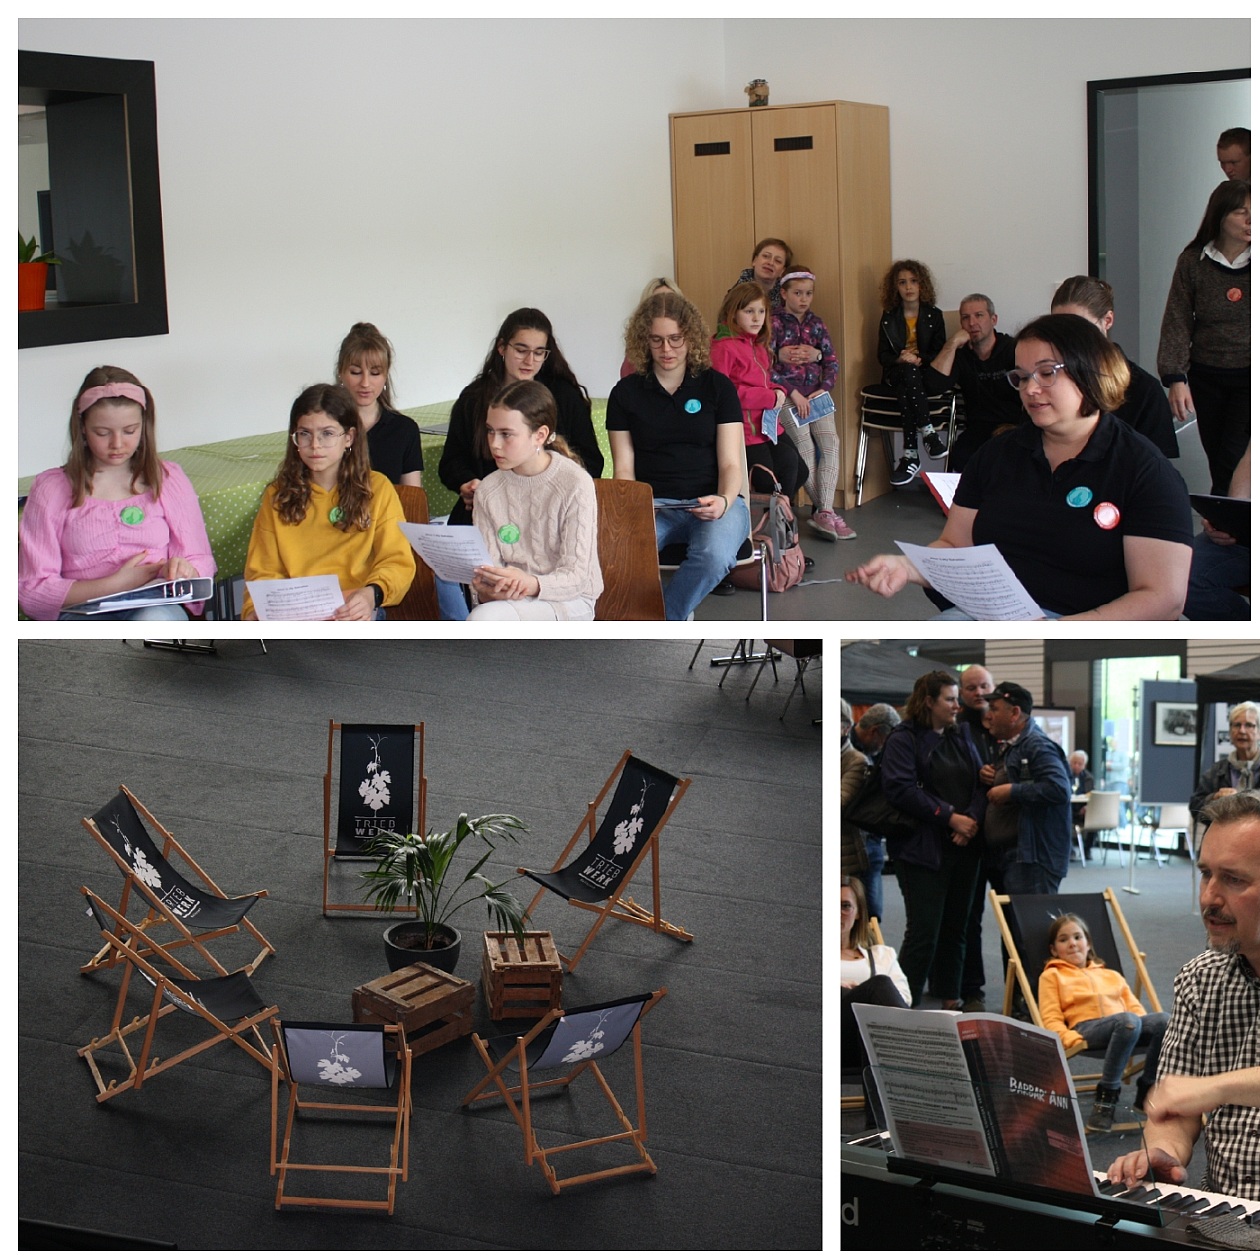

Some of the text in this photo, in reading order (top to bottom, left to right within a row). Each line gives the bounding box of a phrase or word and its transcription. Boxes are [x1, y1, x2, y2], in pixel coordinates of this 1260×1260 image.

[354, 819, 396, 828] TRIEB
[354, 828, 395, 836] WEK
[591, 857, 620, 878] TRIEB
[583, 865, 613, 886] WERK
